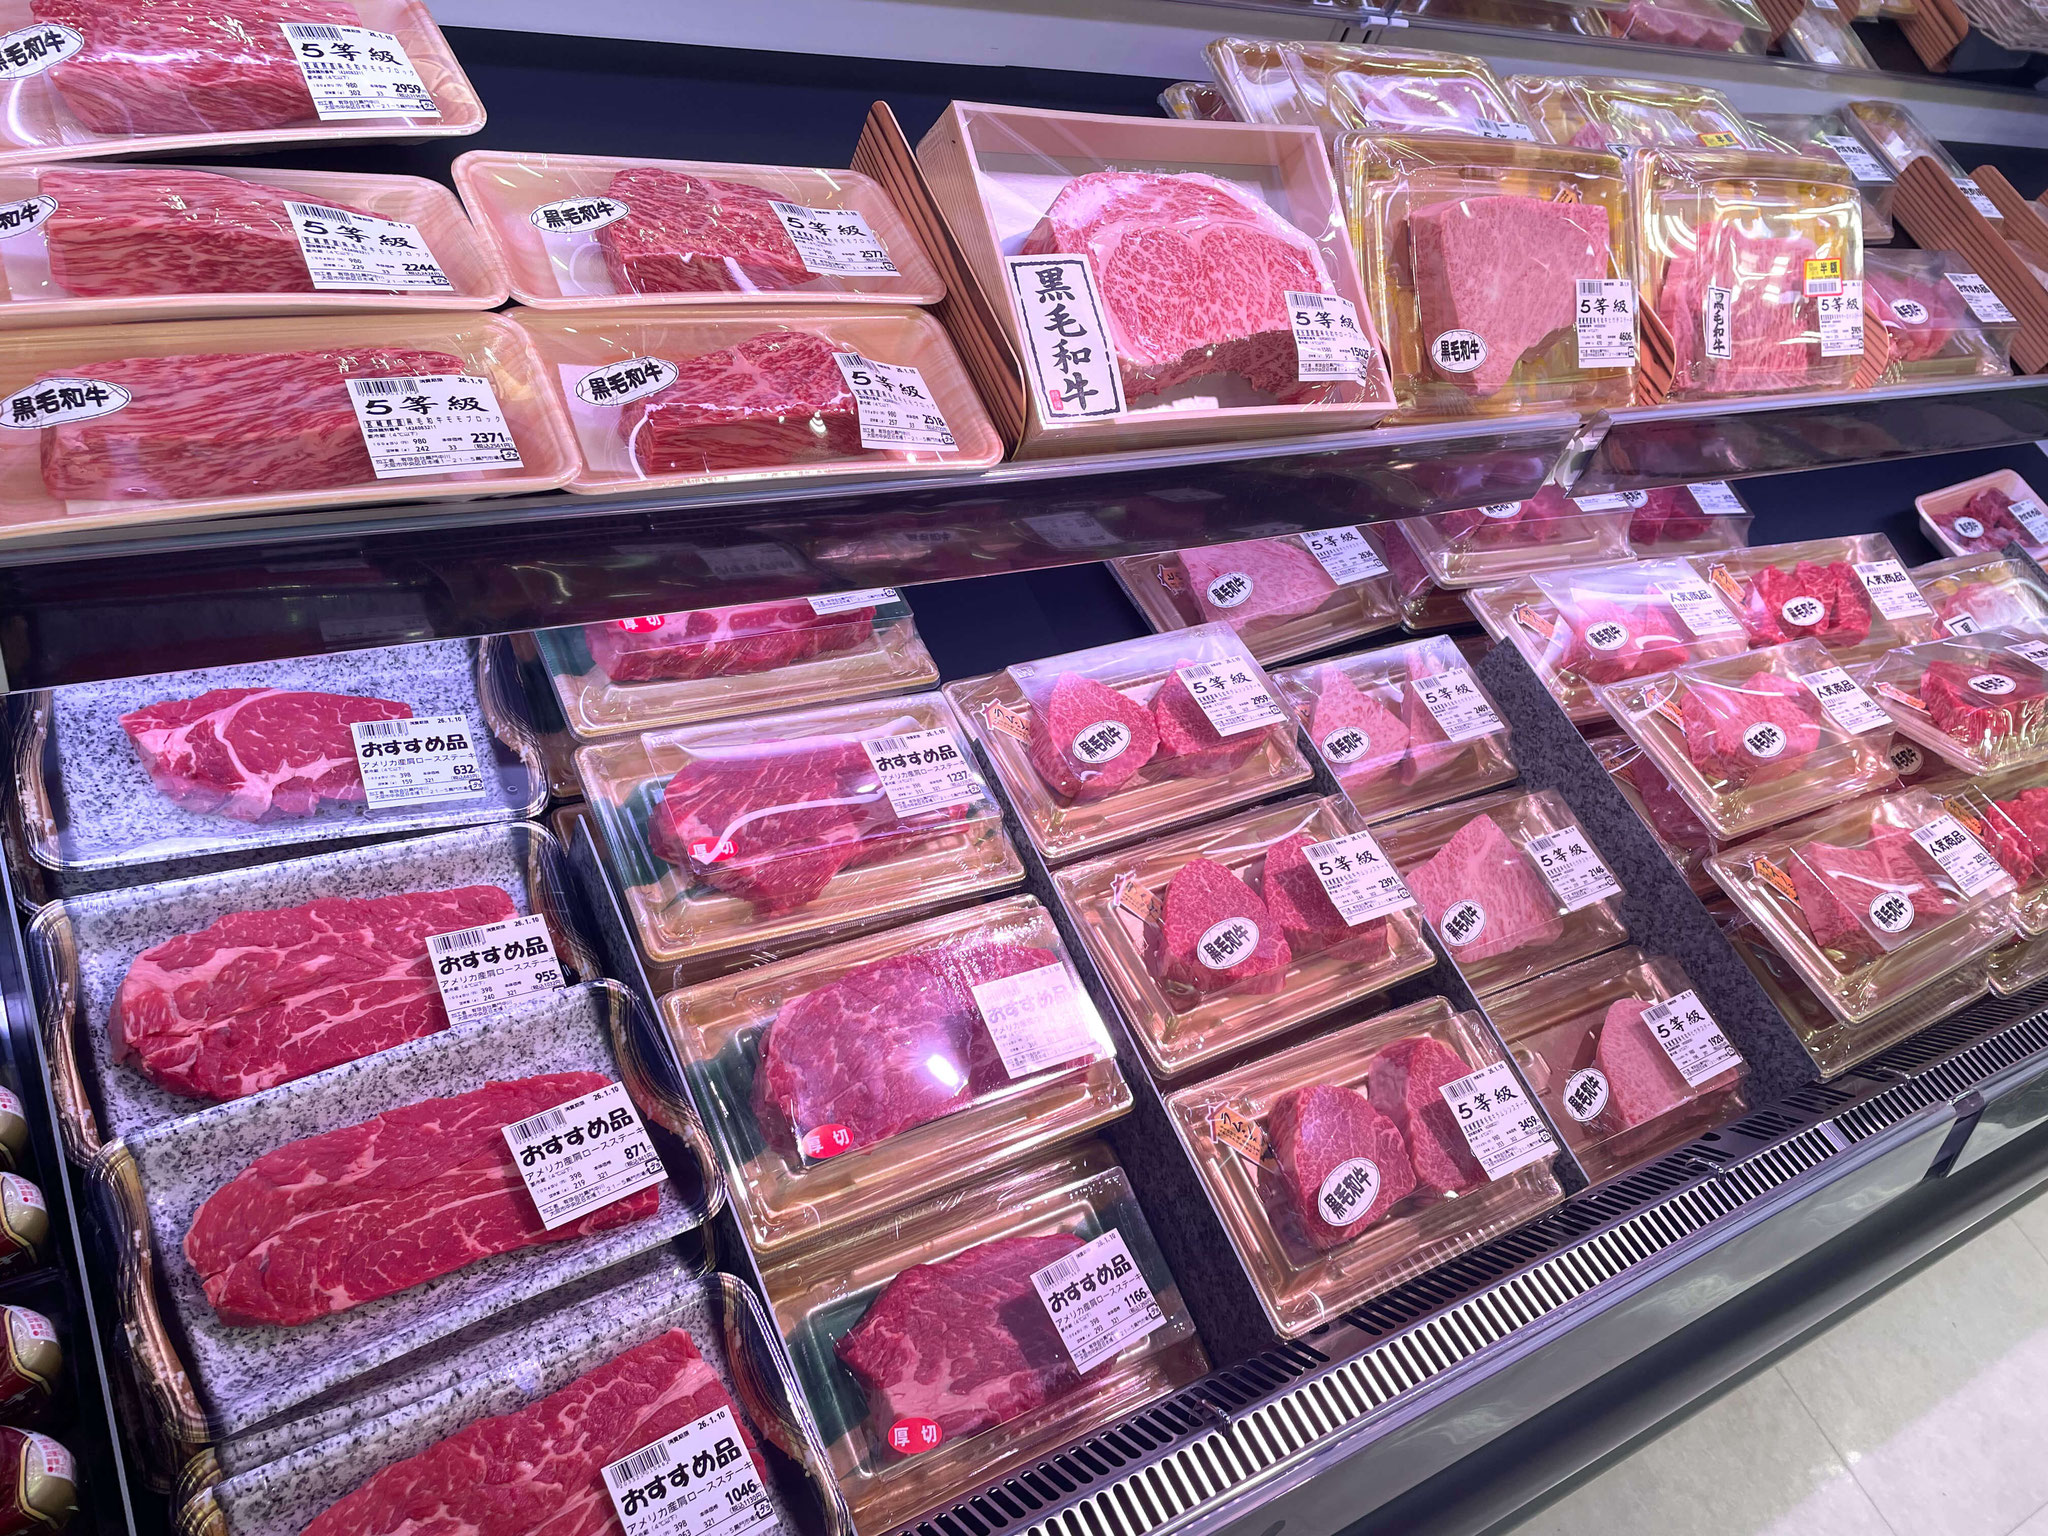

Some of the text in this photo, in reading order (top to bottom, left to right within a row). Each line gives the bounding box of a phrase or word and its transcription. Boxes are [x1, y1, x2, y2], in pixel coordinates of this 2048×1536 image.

[301, 43, 403, 65] 5等級
[393, 83, 421, 94] 2959
[543, 200, 615, 229] 黒毛和牛
[303, 221, 418, 249] 5等級
[787, 216, 867, 237] 5等級
[402, 263, 436, 272] 2244
[1580, 297, 1629, 316] 5等級
[1821, 296, 1860, 313] 5等級
[1296, 311, 1358, 334] 5等級
[1034, 267, 1098, 411] 黒毛和牛
[1440, 340, 1480, 363] 黒毛和牛
[458, 377, 483, 385] 26.1.9
[589, 361, 663, 402] 黒毛和牛
[852, 371, 927, 400] 5等級
[13, 385, 110, 424] 黒毛和牛
[365, 395, 489, 416] 5等級
[1311, 531, 1359, 551] 5等級
[1210, 576, 1247, 605] 黒毛和牛
[1866, 571, 1907, 587] 人気商品
[1670, 589, 1713, 603] 人気商品
[1589, 625, 1623, 647] 黒毛和牛
[1192, 672, 1253, 694] 5等級
[1425, 683, 1474, 704] 5等級
[1816, 679, 1856, 698] 人気商品
[437, 716, 462, 724] 26.1.10
[361, 733, 468, 758] おすすめ品
[1078, 725, 1122, 759] 黒毛和牛
[1327, 731, 1364, 760] 黒毛和牛
[1747, 727, 1782, 755] 黒毛和牛
[453, 764, 475, 775] 632
[876, 744, 958, 772] おすすめ品
[946, 770, 968, 783] 1237
[1540, 843, 1588, 867] 5等級
[1929, 830, 1967, 858] 人気商品
[1319, 850, 1379, 876] 5等級
[1378, 876, 1399, 888] 2391
[514, 916, 540, 927] 26.1.10
[1445, 904, 1480, 942] 黒毛和牛
[1873, 896, 1909, 929] 黒毛和牛
[1203, 923, 1250, 964] 黒毛和牛
[439, 936, 549, 976] おすすめ品
[440, 956, 559, 989] アメリカ産肩ロースステーキ
[481, 969, 558, 994] 398 955
[483, 993, 495, 1001] 240
[506, 989, 517, 997] 321
[1656, 1009, 1706, 1039] 5等級
[1707, 1034, 1724, 1047] 1920
[593, 1086, 619, 1101] 26.1.10
[1457, 1085, 1519, 1120] 5等級
[1568, 1075, 1603, 1117] 黒毛和牛
[1518, 1116, 1538, 1131] 3459
[520, 1107, 635, 1167] おすすめ品
[525, 1126, 645, 1185] アメリカ産肩ロースステーキ
[570, 1172, 583, 1181] 398
[573, 1179, 586, 1189] 219
[597, 1171, 609, 1179] 321
[1323, 1166, 1374, 1220] 黒毛和牛
[1048, 1253, 1133, 1313] おすすめ品
[1055, 1272, 1143, 1328] アメリカ産肩ロースステーキ
[1123, 1287, 1148, 1307] 1166
[1093, 1324, 1104, 1335] 293
[697, 1410, 726, 1430] 26.1.10
[894, 1424, 937, 1448] 厚切
[621, 1436, 743, 1517] おすすめ品
[627, 1461, 754, 1535] アメリカ産肩ロースステーキ
[674, 1519, 688, 1531] 398
[703, 1517, 715, 1528] 321
